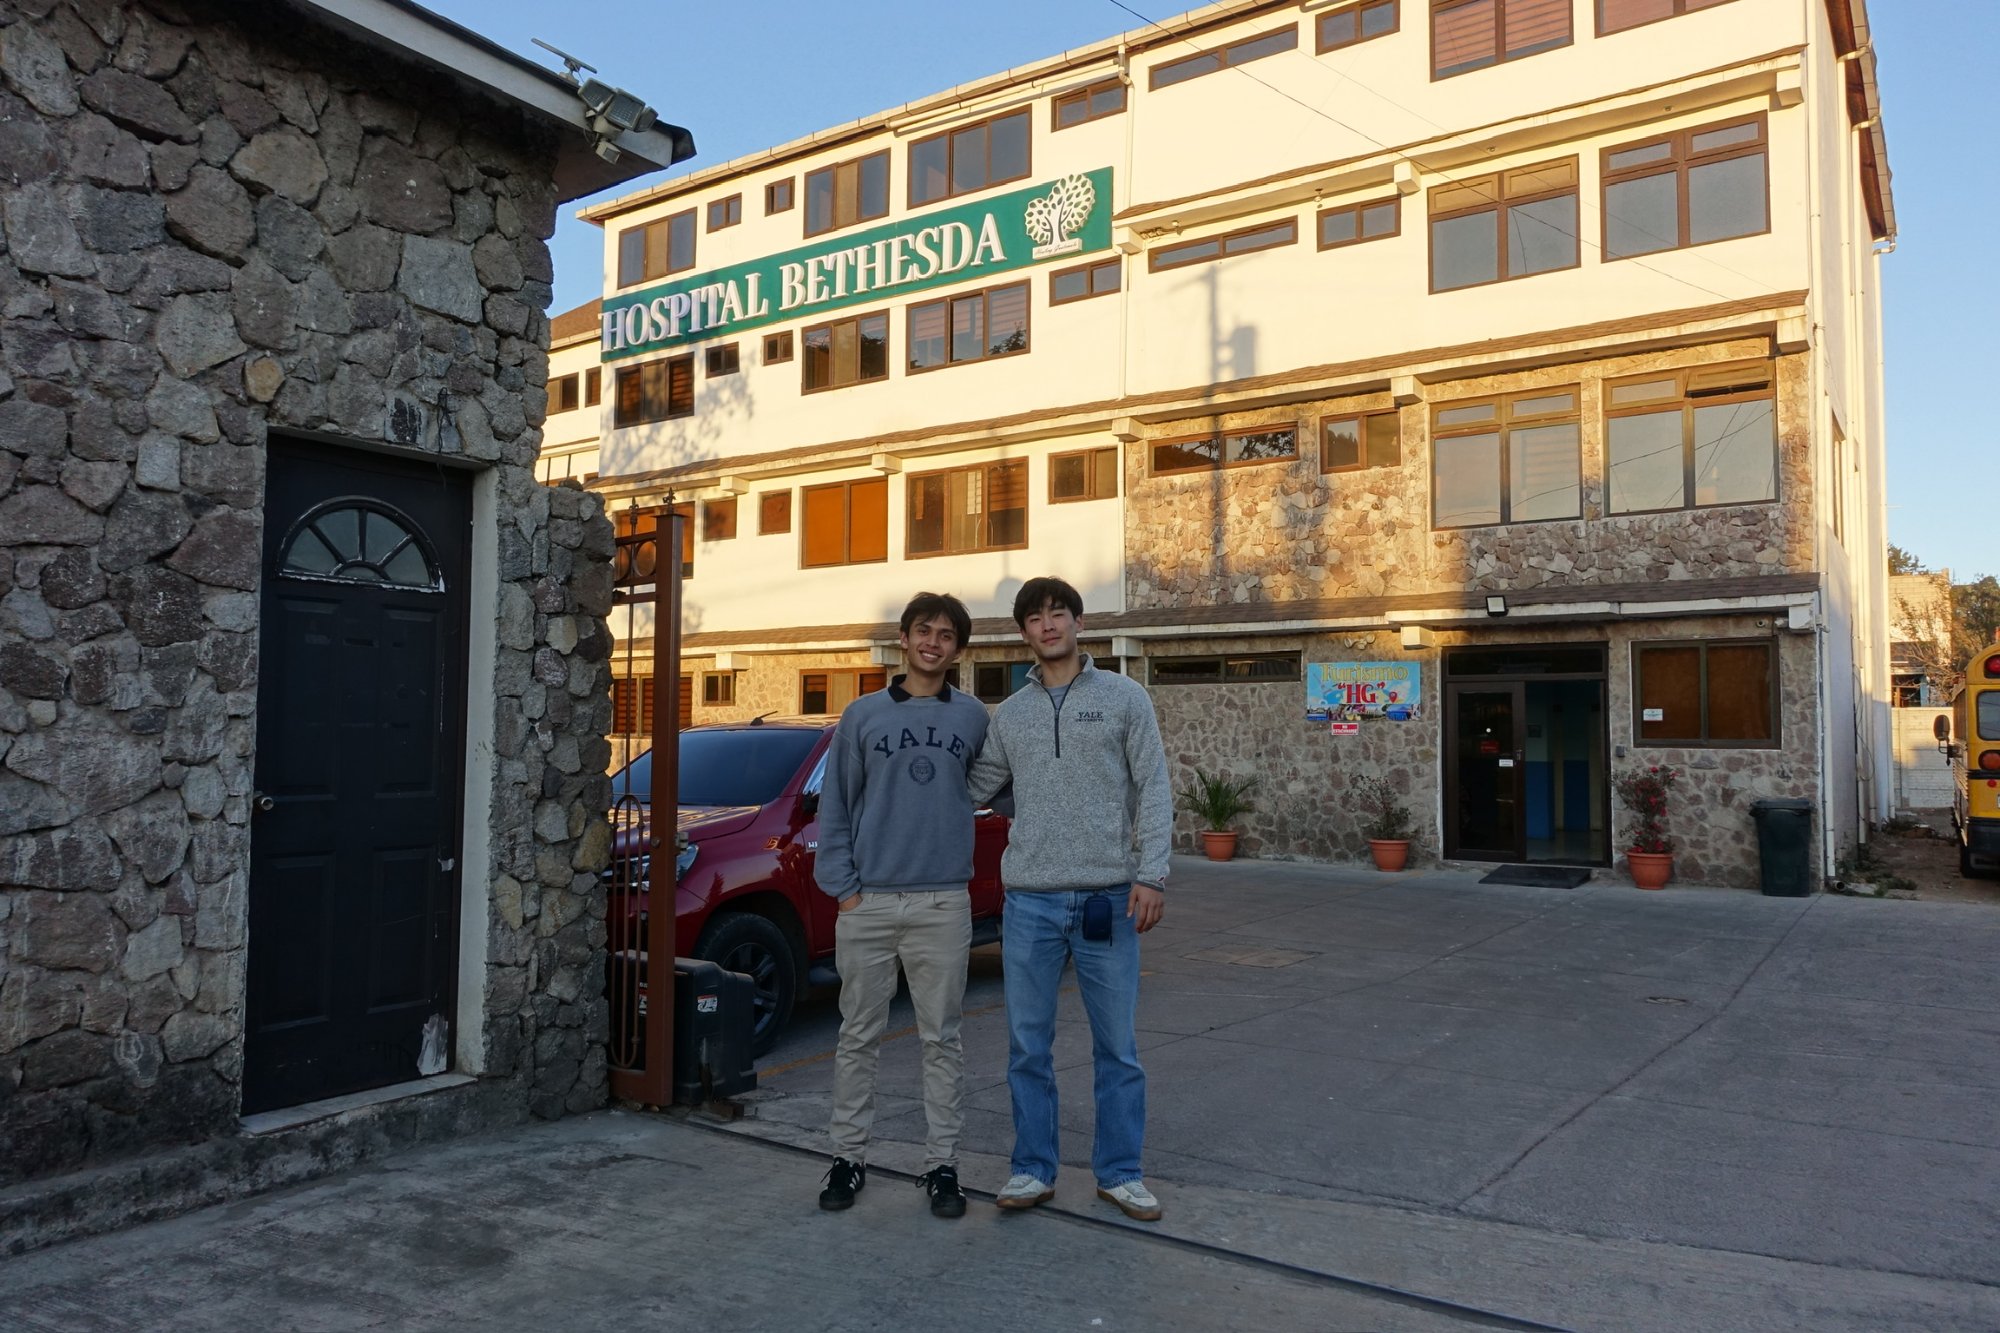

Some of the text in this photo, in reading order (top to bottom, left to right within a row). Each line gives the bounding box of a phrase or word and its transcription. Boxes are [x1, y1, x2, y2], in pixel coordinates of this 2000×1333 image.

[598, 213, 1008, 353] HOSPITAL BETHESDA
[1320, 663, 1408, 681] Turismo
[873, 726, 965, 759] YALE
